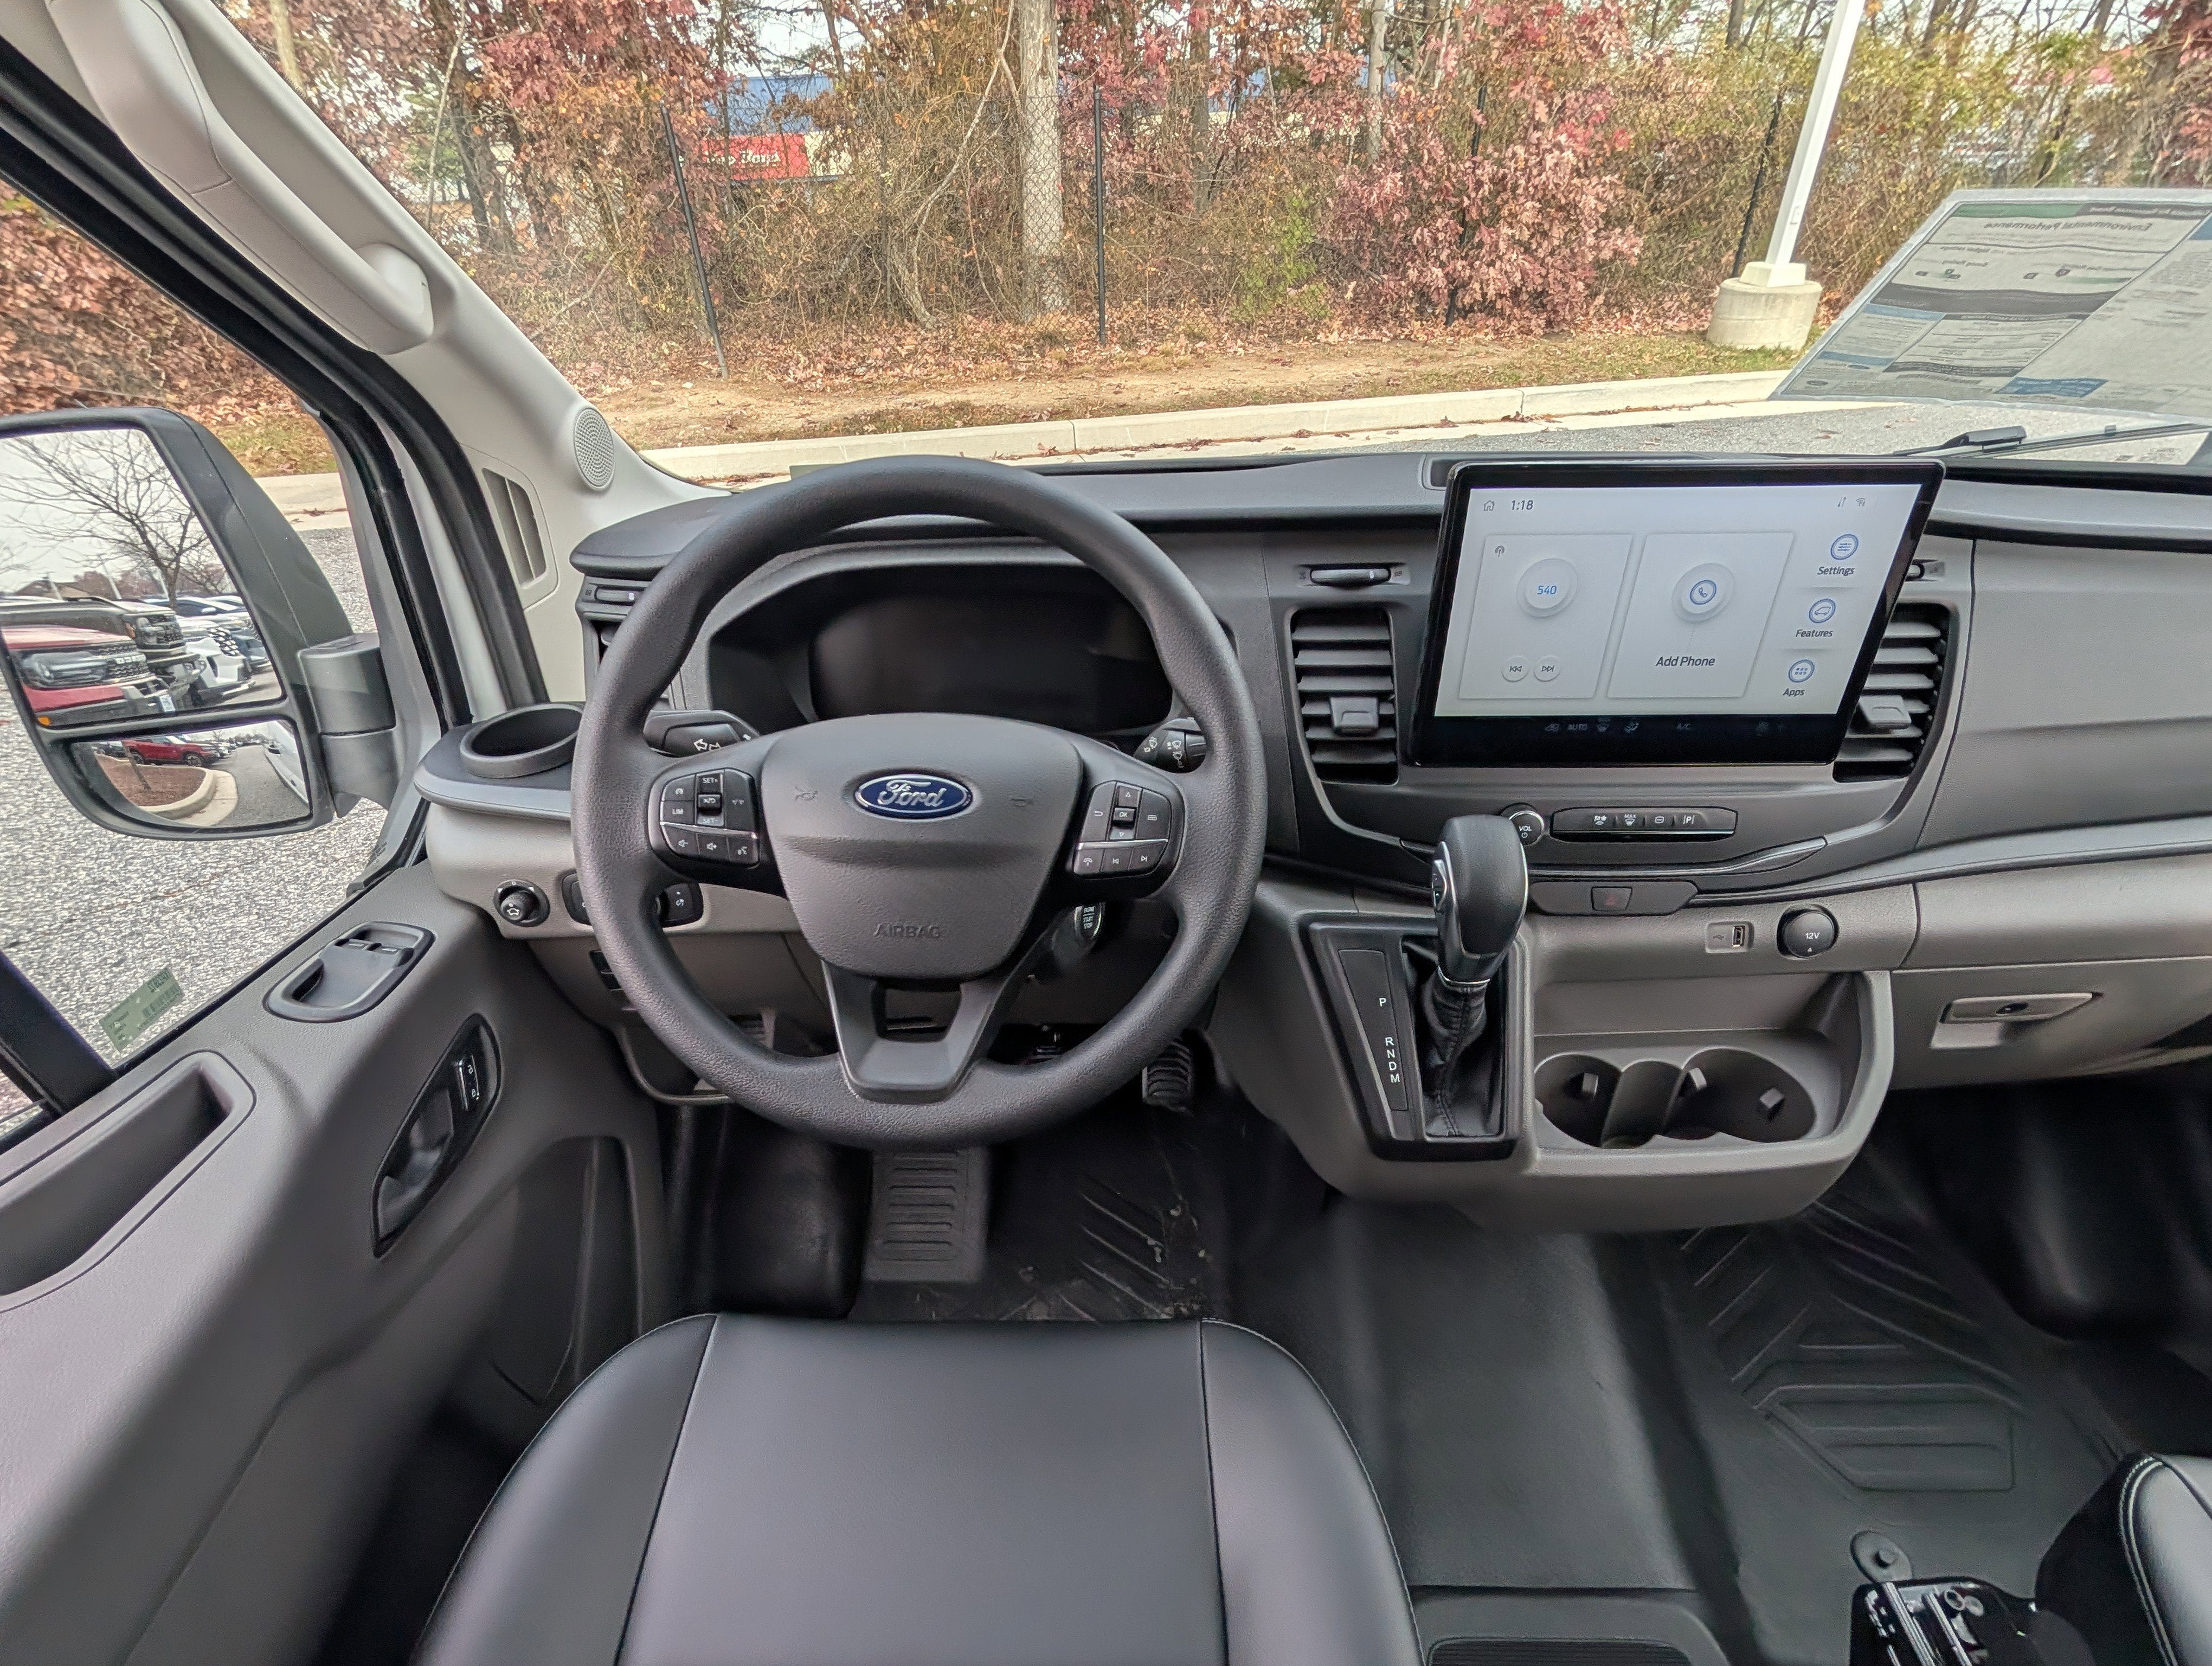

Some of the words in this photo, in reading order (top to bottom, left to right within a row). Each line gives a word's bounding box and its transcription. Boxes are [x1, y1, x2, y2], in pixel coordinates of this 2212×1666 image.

[1512, 500, 1533, 511] 1:18
[1817, 566, 1855, 576] Settings
[1537, 585, 1558, 595] 540
[1796, 629, 1834, 638] Features
[1655, 656, 1679, 667] Add
[1680, 656, 1716, 667] Phone
[1783, 688, 1805, 697] Apps
[1567, 723, 1588, 731] AUTO
[877, 779, 947, 808] Ford
[872, 922, 941, 939] AIRBAG
[1379, 997, 1386, 1007] P
[1385, 1036, 1394, 1046] R
[1386, 1049, 1396, 1059] N
[1388, 1061, 1397, 1071] D
[1390, 1073, 1400, 1084] M
